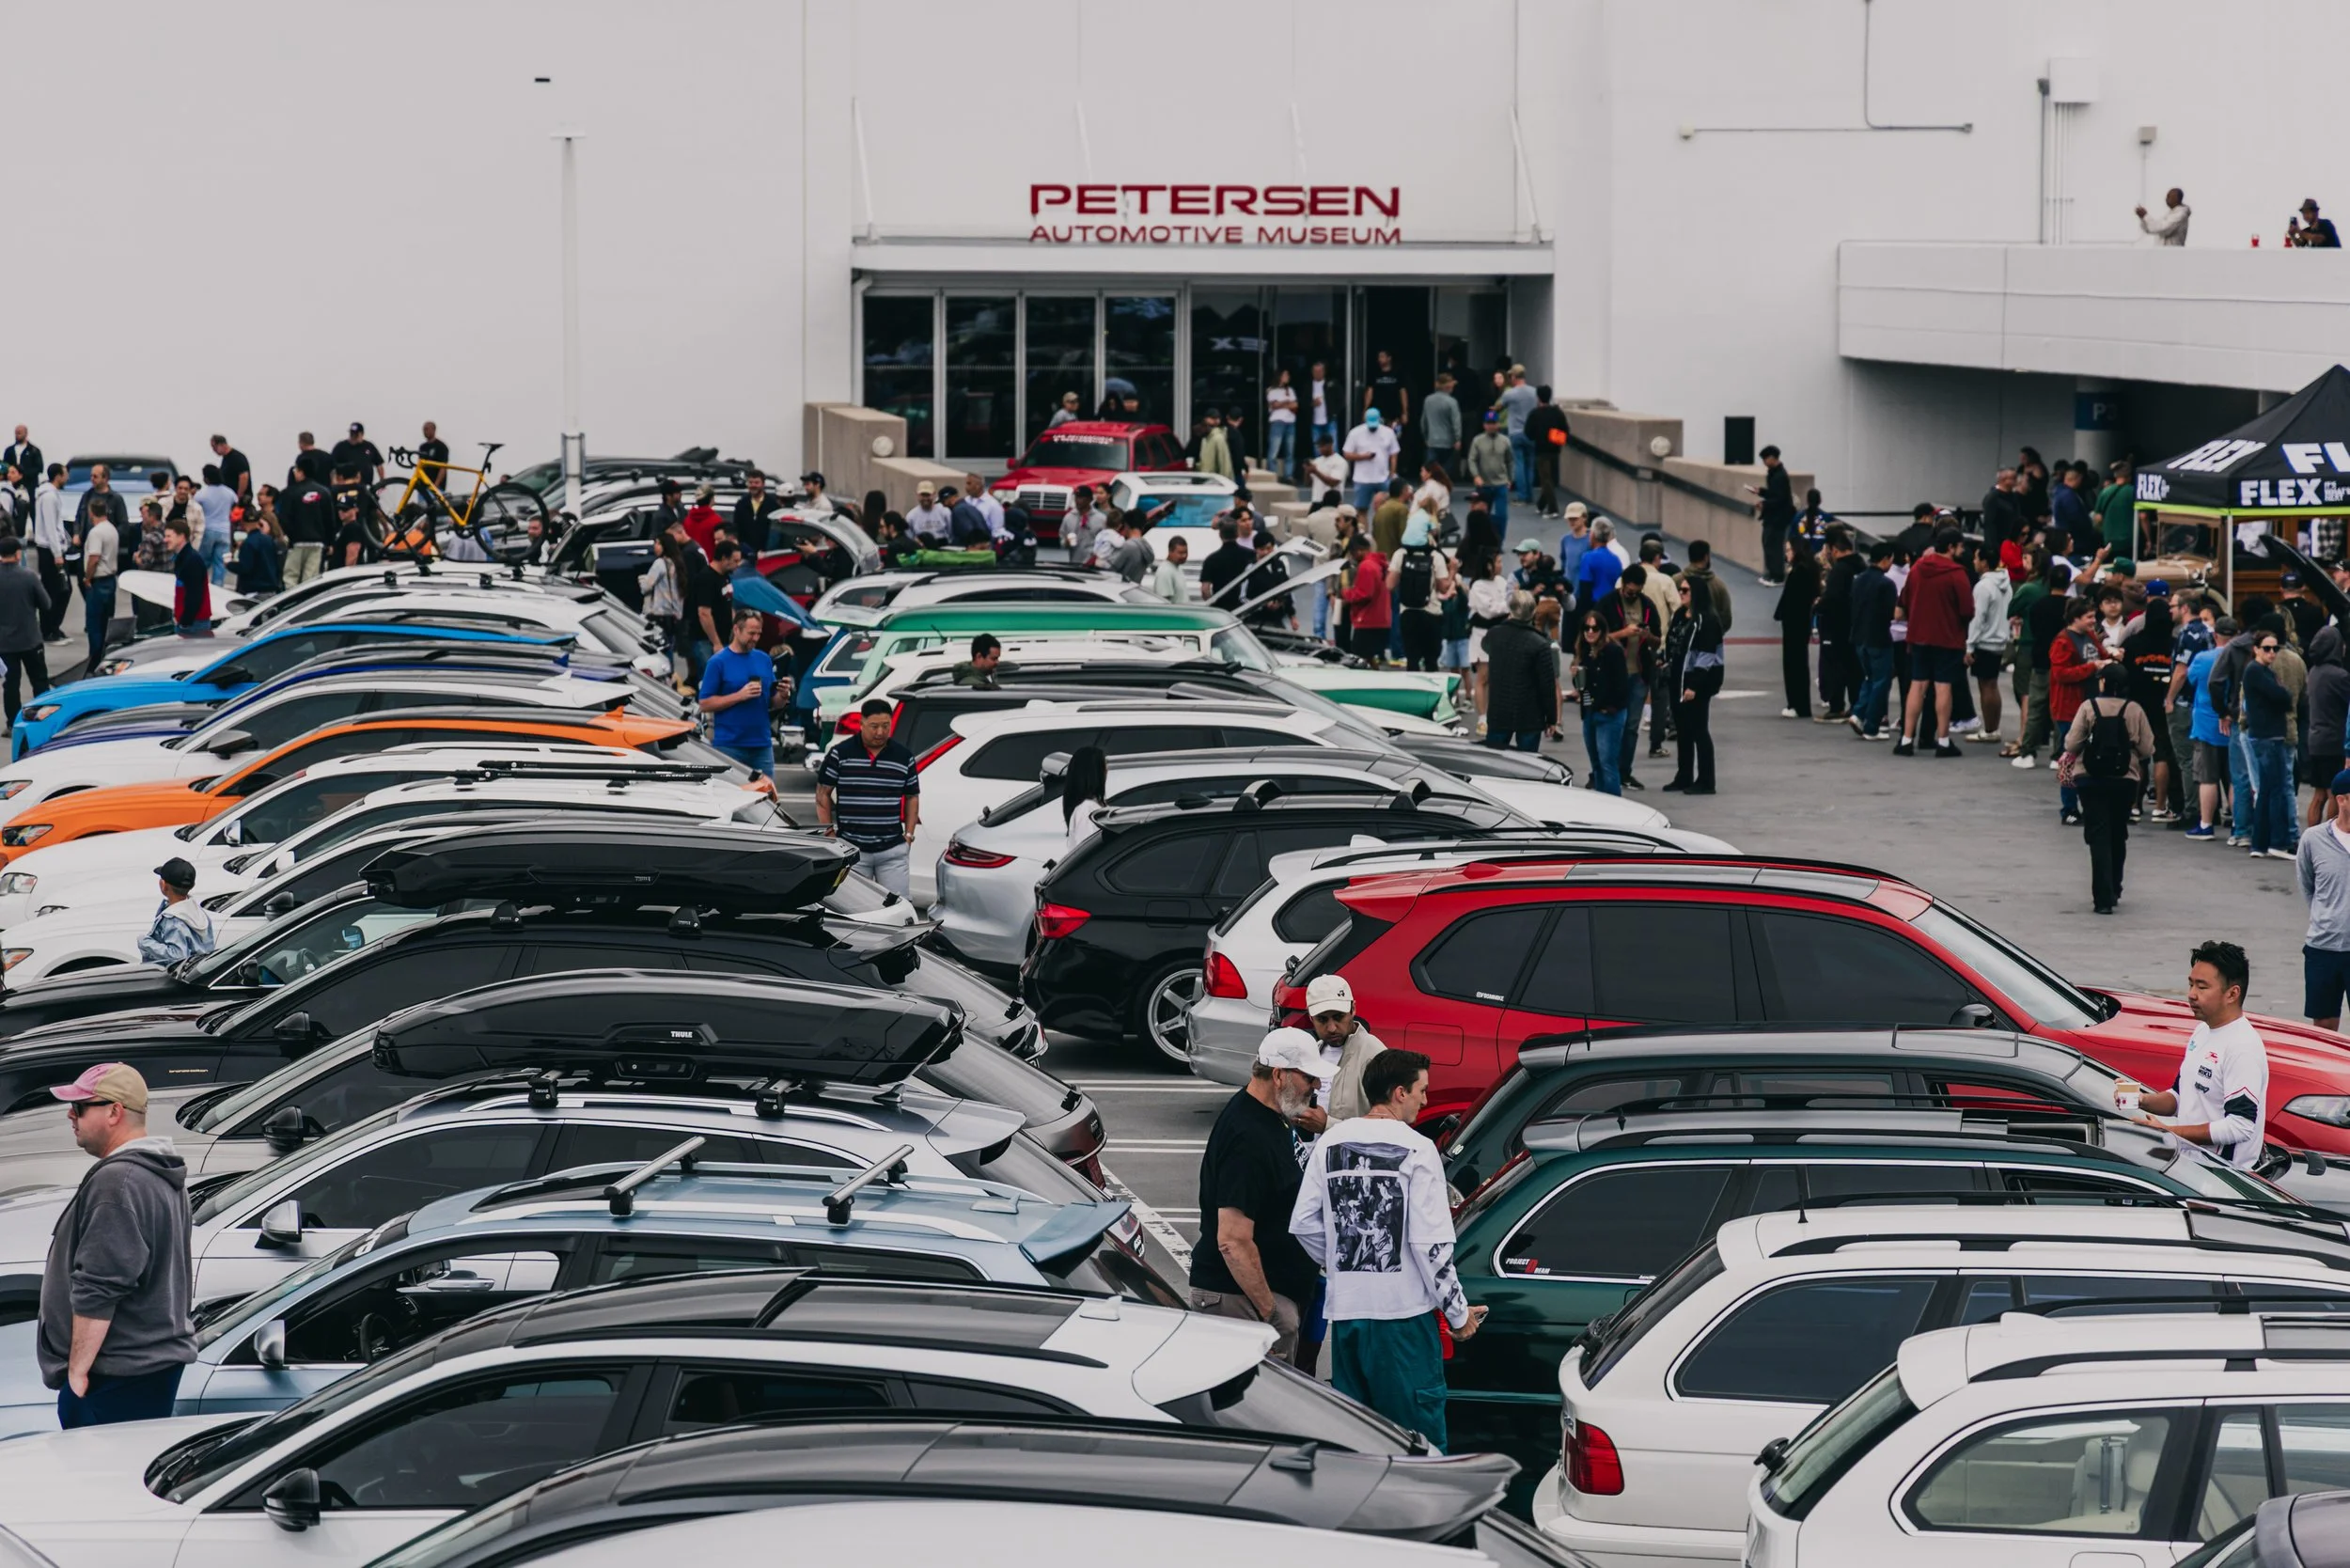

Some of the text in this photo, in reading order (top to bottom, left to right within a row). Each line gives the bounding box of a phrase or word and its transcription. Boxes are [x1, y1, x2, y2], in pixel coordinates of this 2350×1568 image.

[1030, 183, 1400, 217] PETERSEN
[1028, 225, 1402, 244] AUTOMOTIVE MUSEUM
[2166, 438, 2267, 473] FLEX
[2136, 473, 2163, 501] FLEX
[2240, 478, 2323, 507] FLEX
[670, 1030, 693, 1039] THULE
